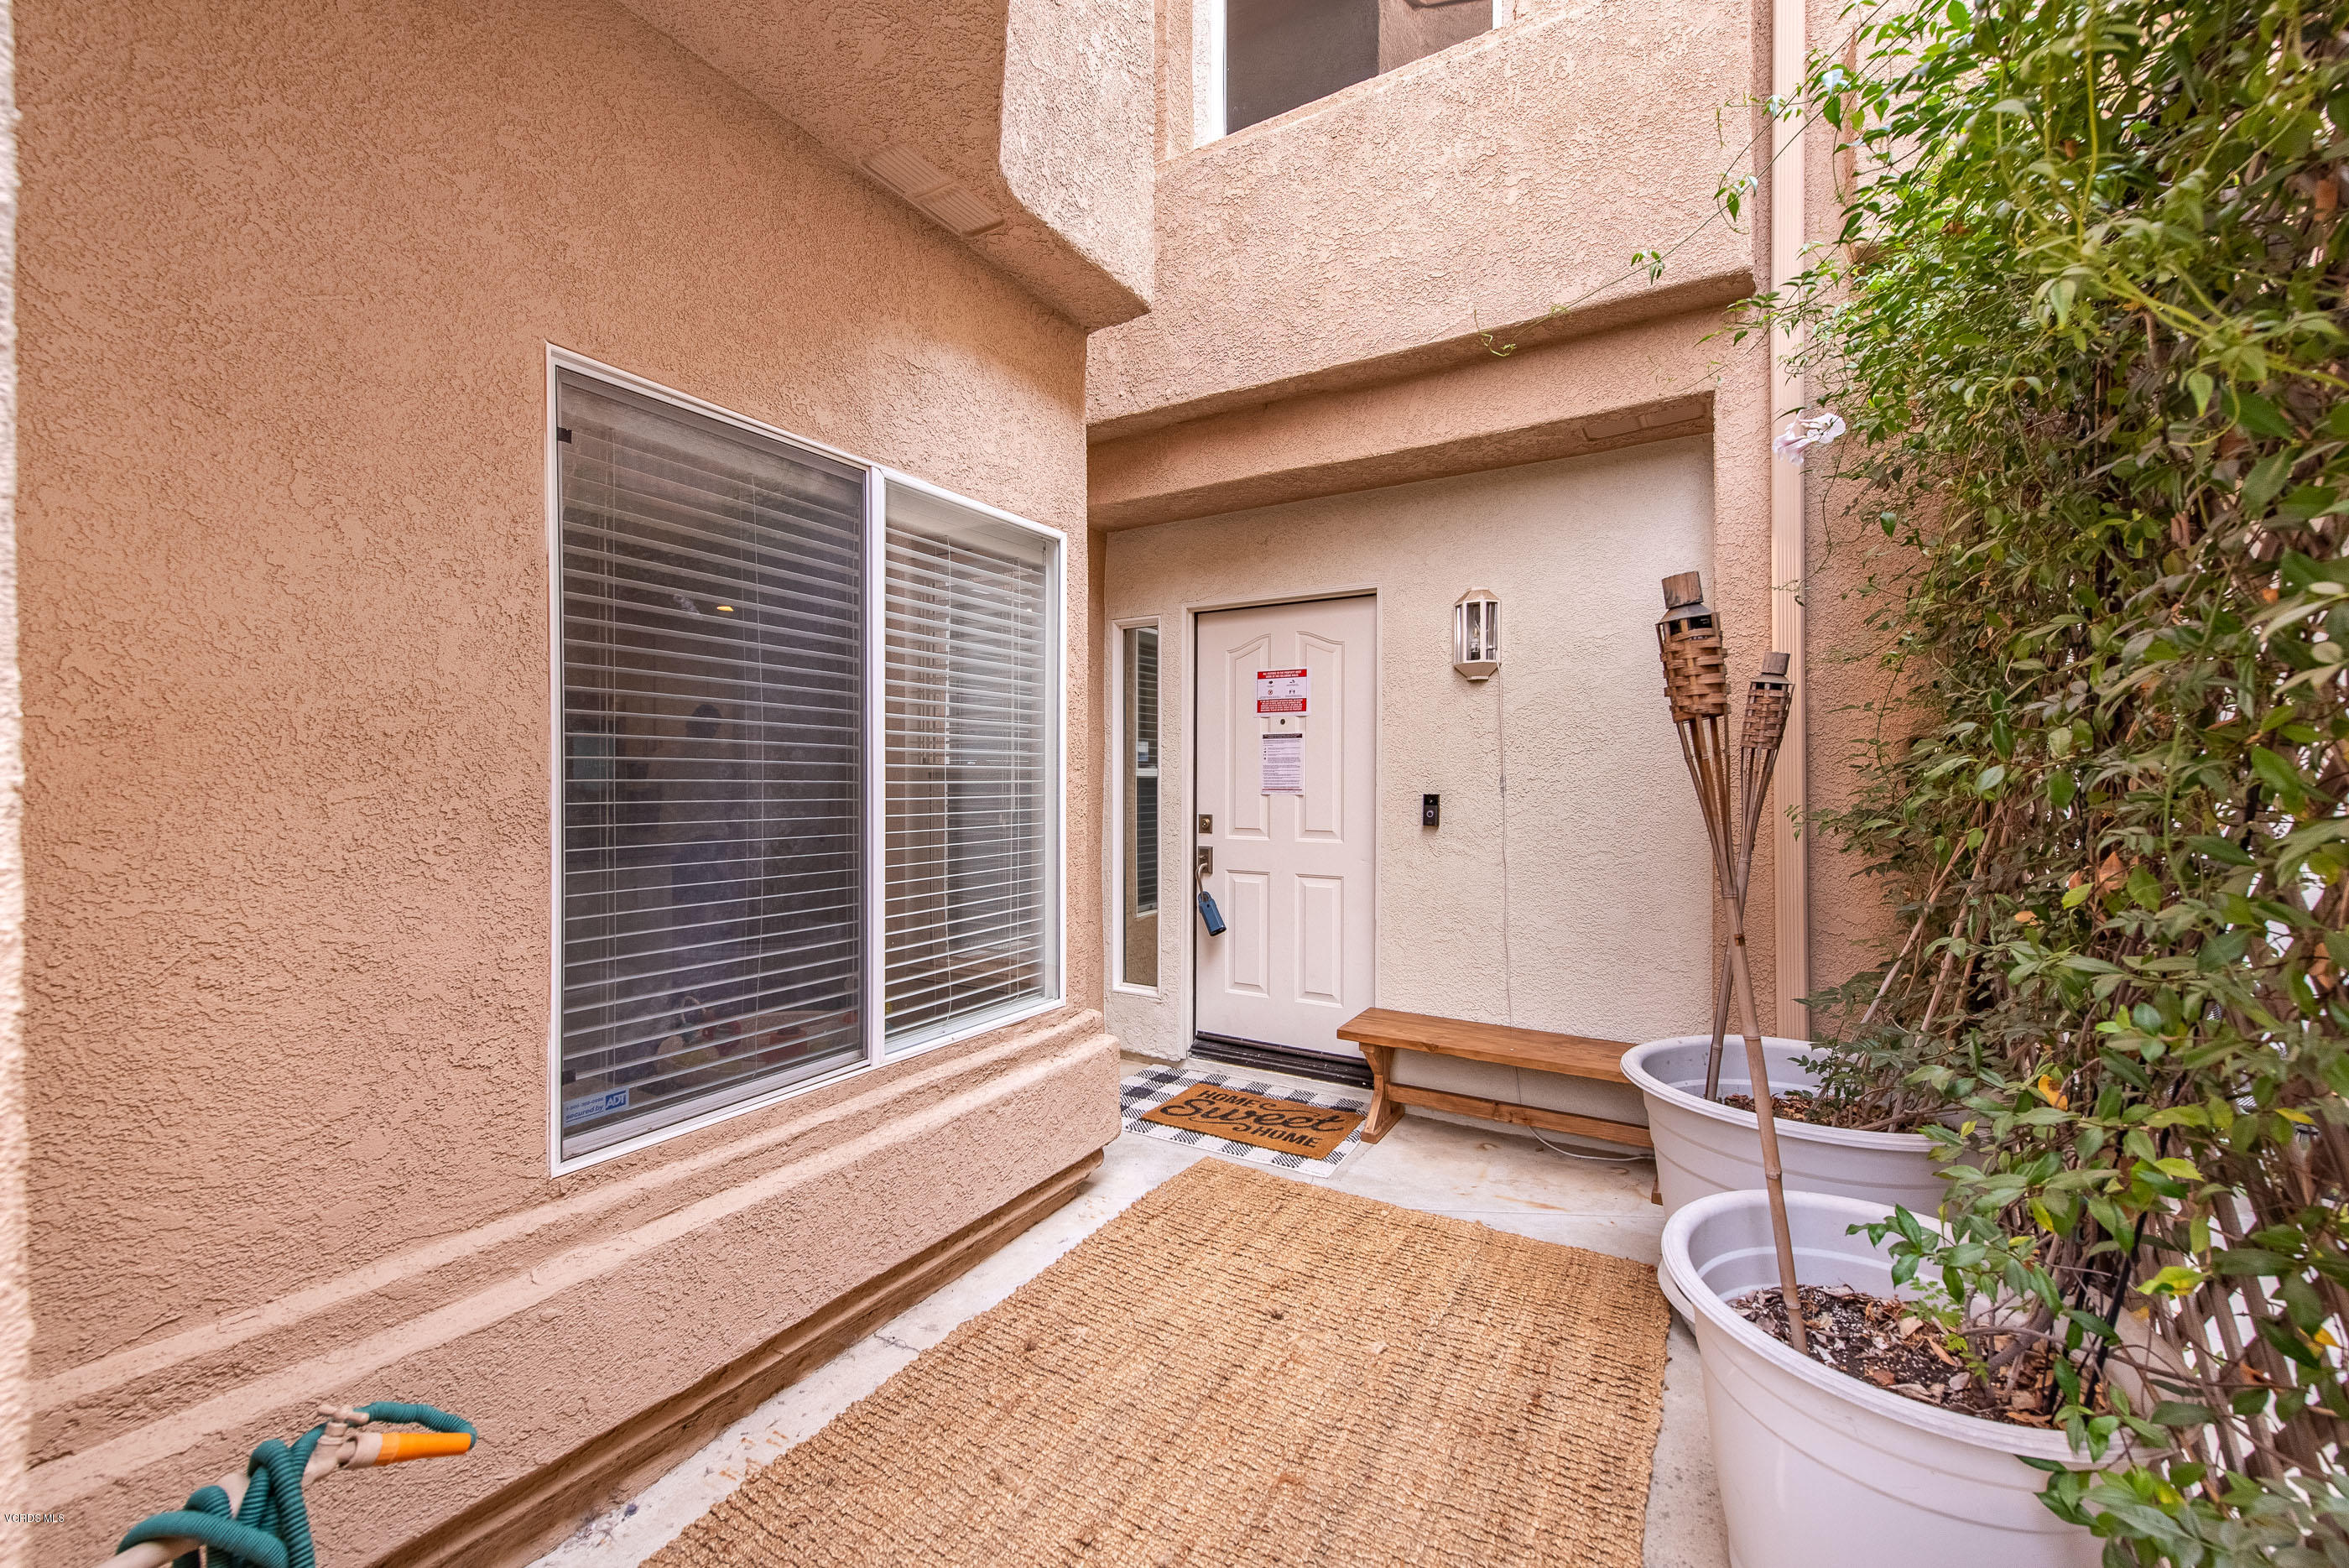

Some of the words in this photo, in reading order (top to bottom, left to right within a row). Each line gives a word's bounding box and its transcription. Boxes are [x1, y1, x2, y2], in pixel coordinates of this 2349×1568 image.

[606, 1093, 626, 1108] ADT
[1197, 1089, 1258, 1108] HOME
[565, 1106, 595, 1120] secured
[595, 1104, 604, 1112] by
[1159, 1098, 1346, 1132] Sweet
[1251, 1127, 1323, 1149] HOME
